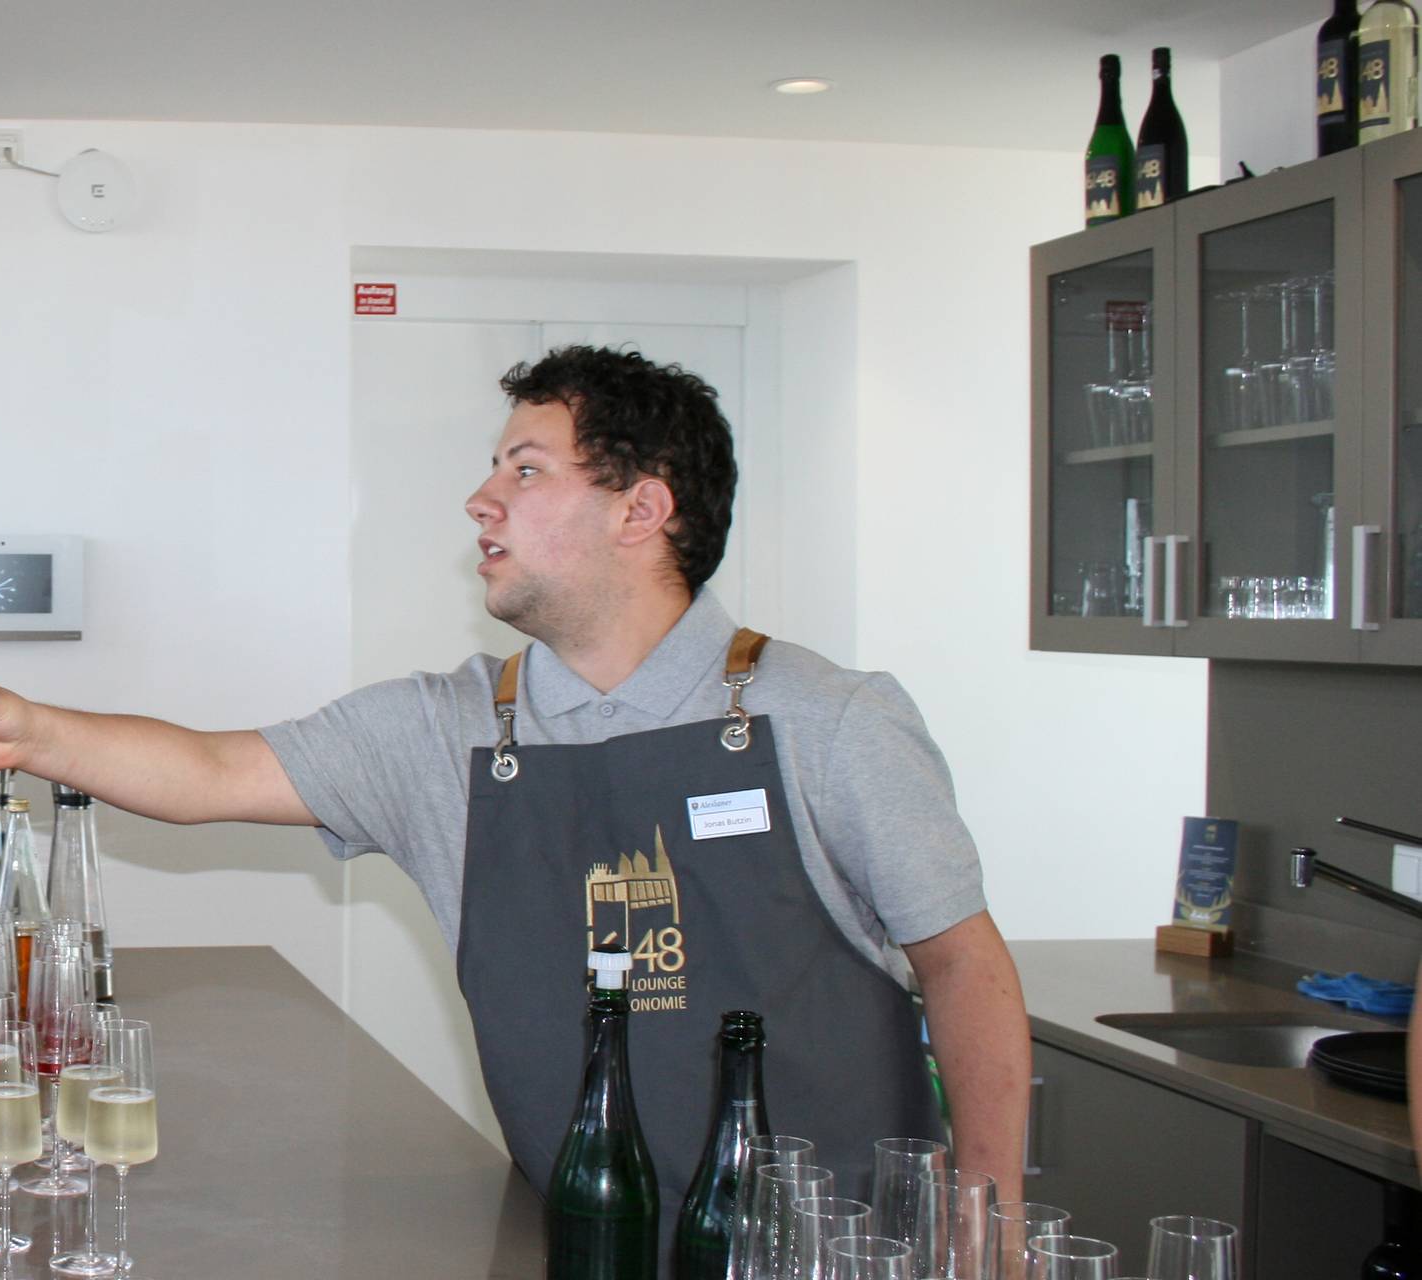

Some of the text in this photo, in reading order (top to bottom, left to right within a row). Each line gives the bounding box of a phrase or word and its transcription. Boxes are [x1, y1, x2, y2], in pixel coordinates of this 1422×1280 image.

[357, 285, 394, 296] Aufzug
[632, 976, 687, 992] LOUNGE
[630, 996, 687, 1012] ONOMIE
